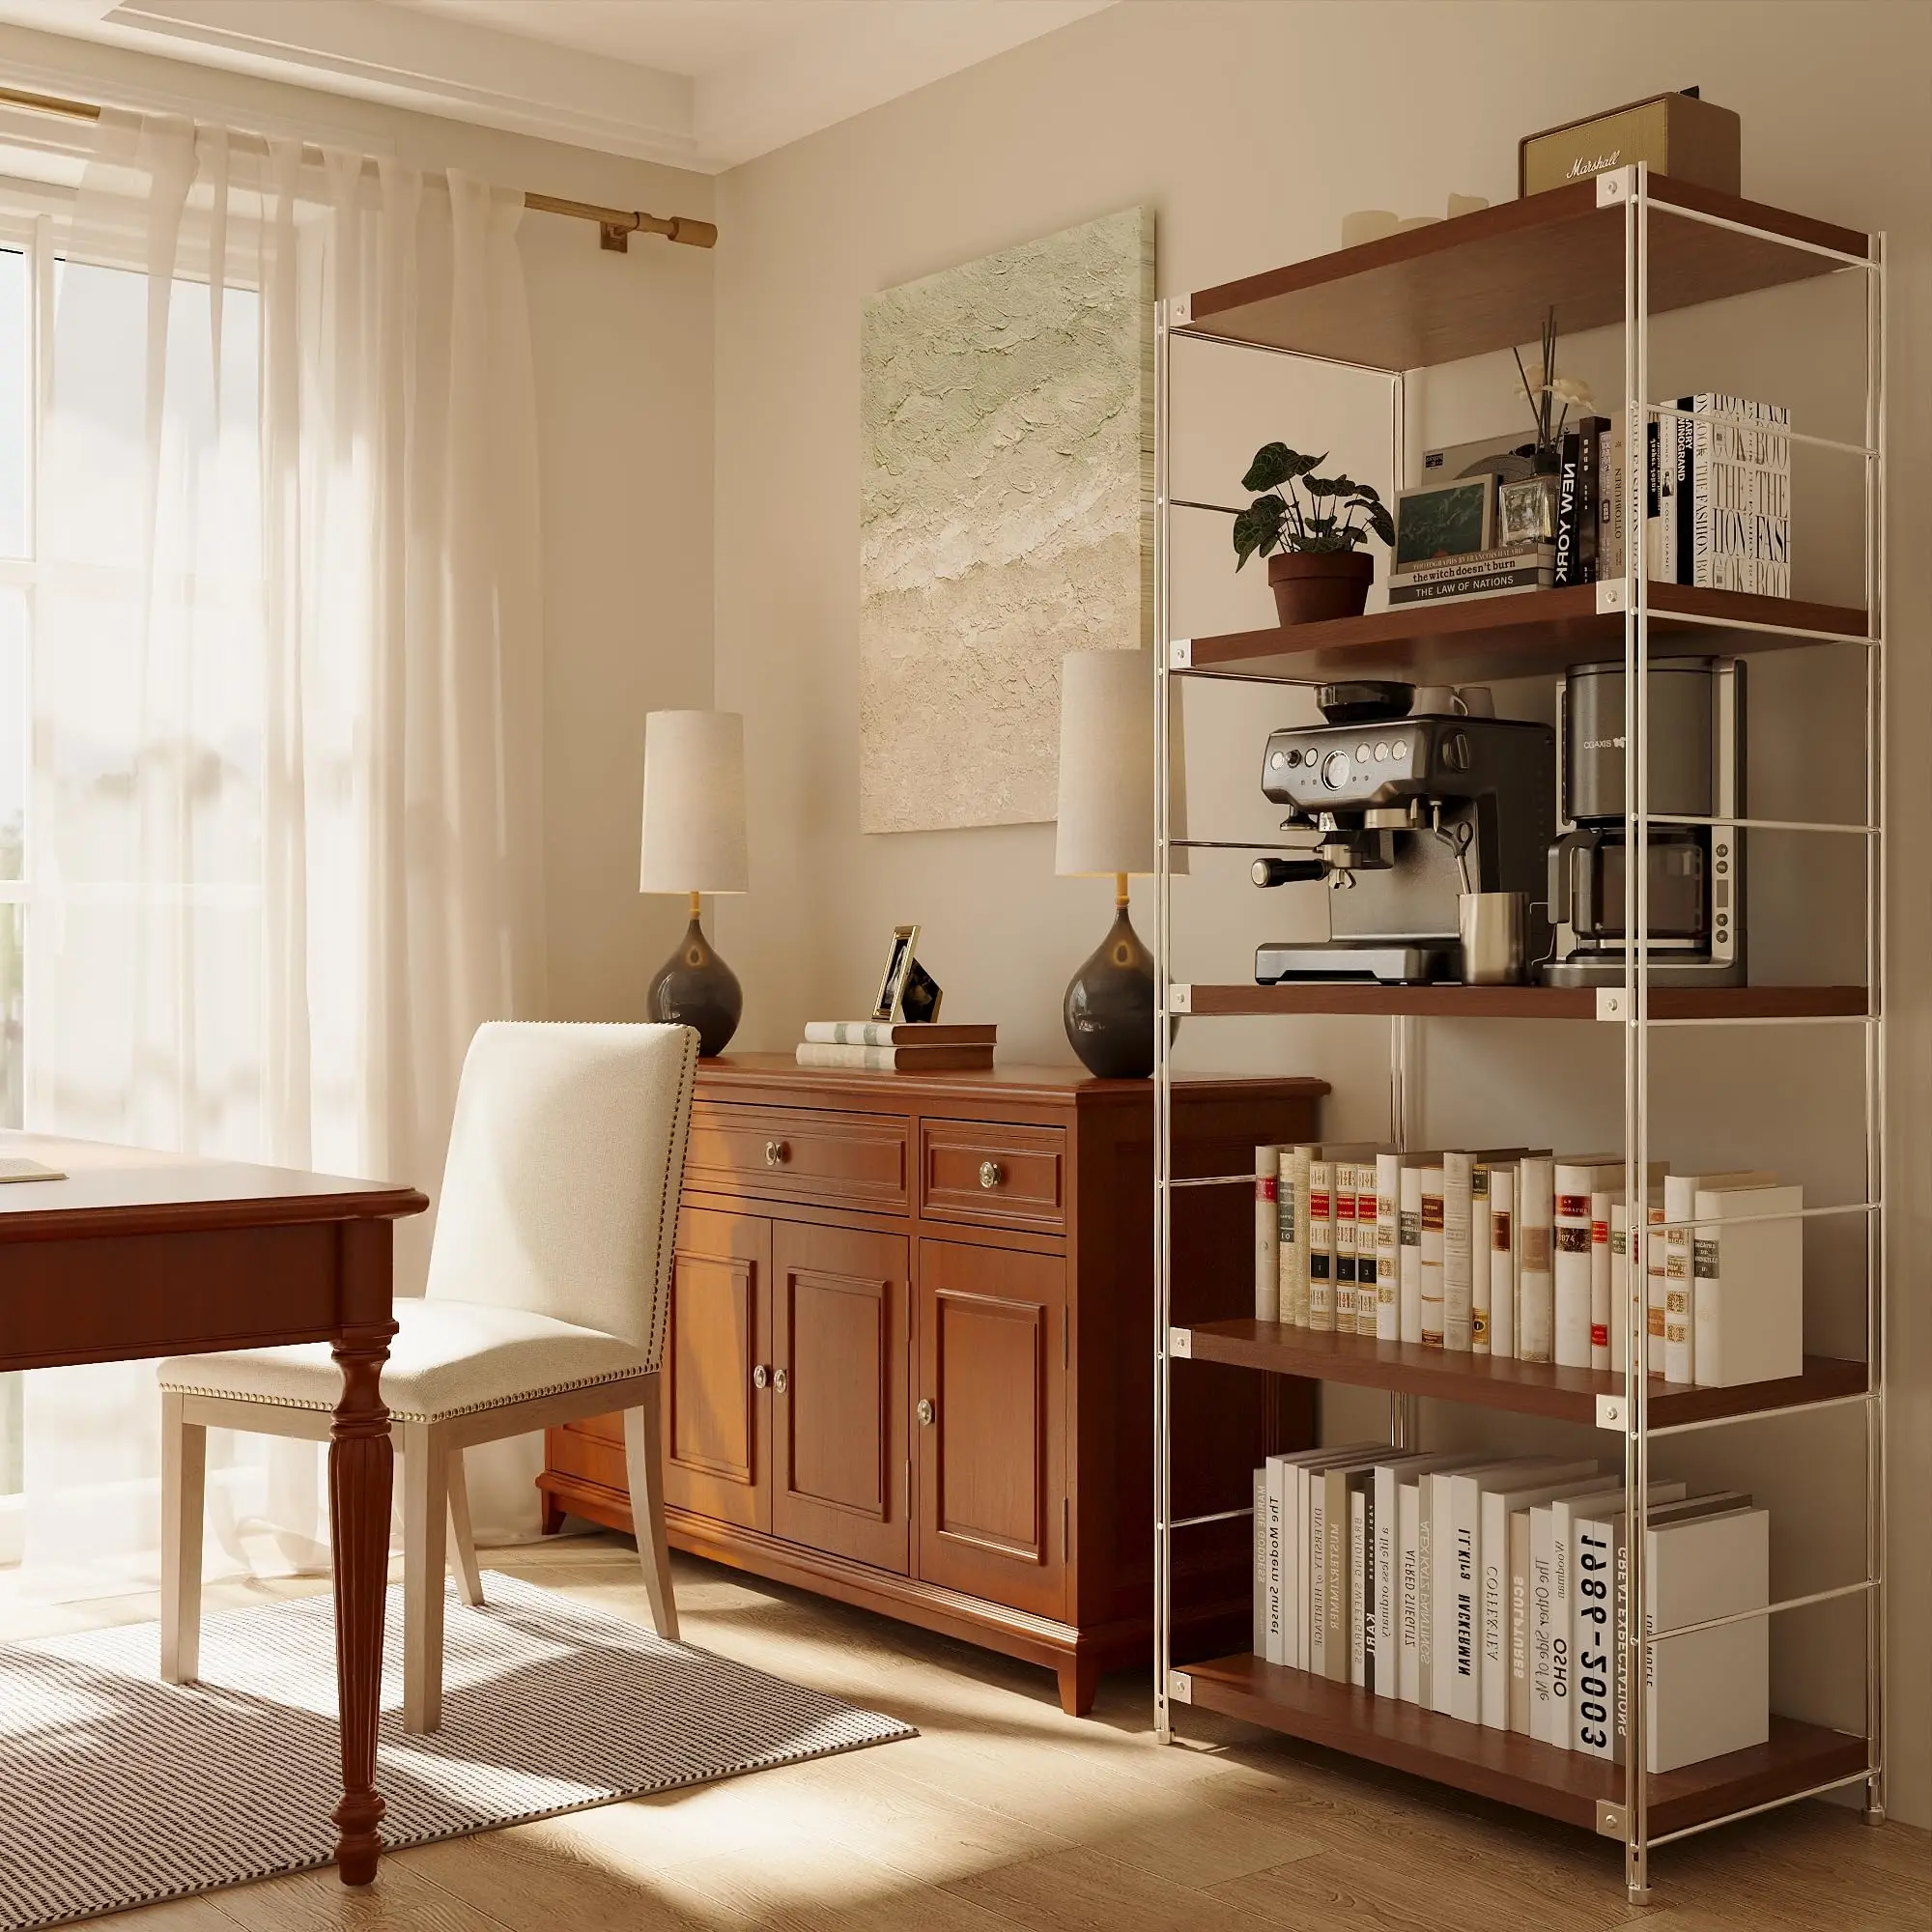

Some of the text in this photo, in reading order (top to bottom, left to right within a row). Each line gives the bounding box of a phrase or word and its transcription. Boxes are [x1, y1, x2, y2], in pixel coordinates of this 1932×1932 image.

[1566, 150, 1620, 179] Marshall
[1685, 418, 1693, 449] ARRY
[1713, 463, 1747, 511] THE
[1755, 469, 1787, 519] THE
[1695, 495, 1708, 555] FASHION
[1492, 559, 1517, 571] burn
[1415, 575, 1515, 598] THE LAW OF NATIONS
